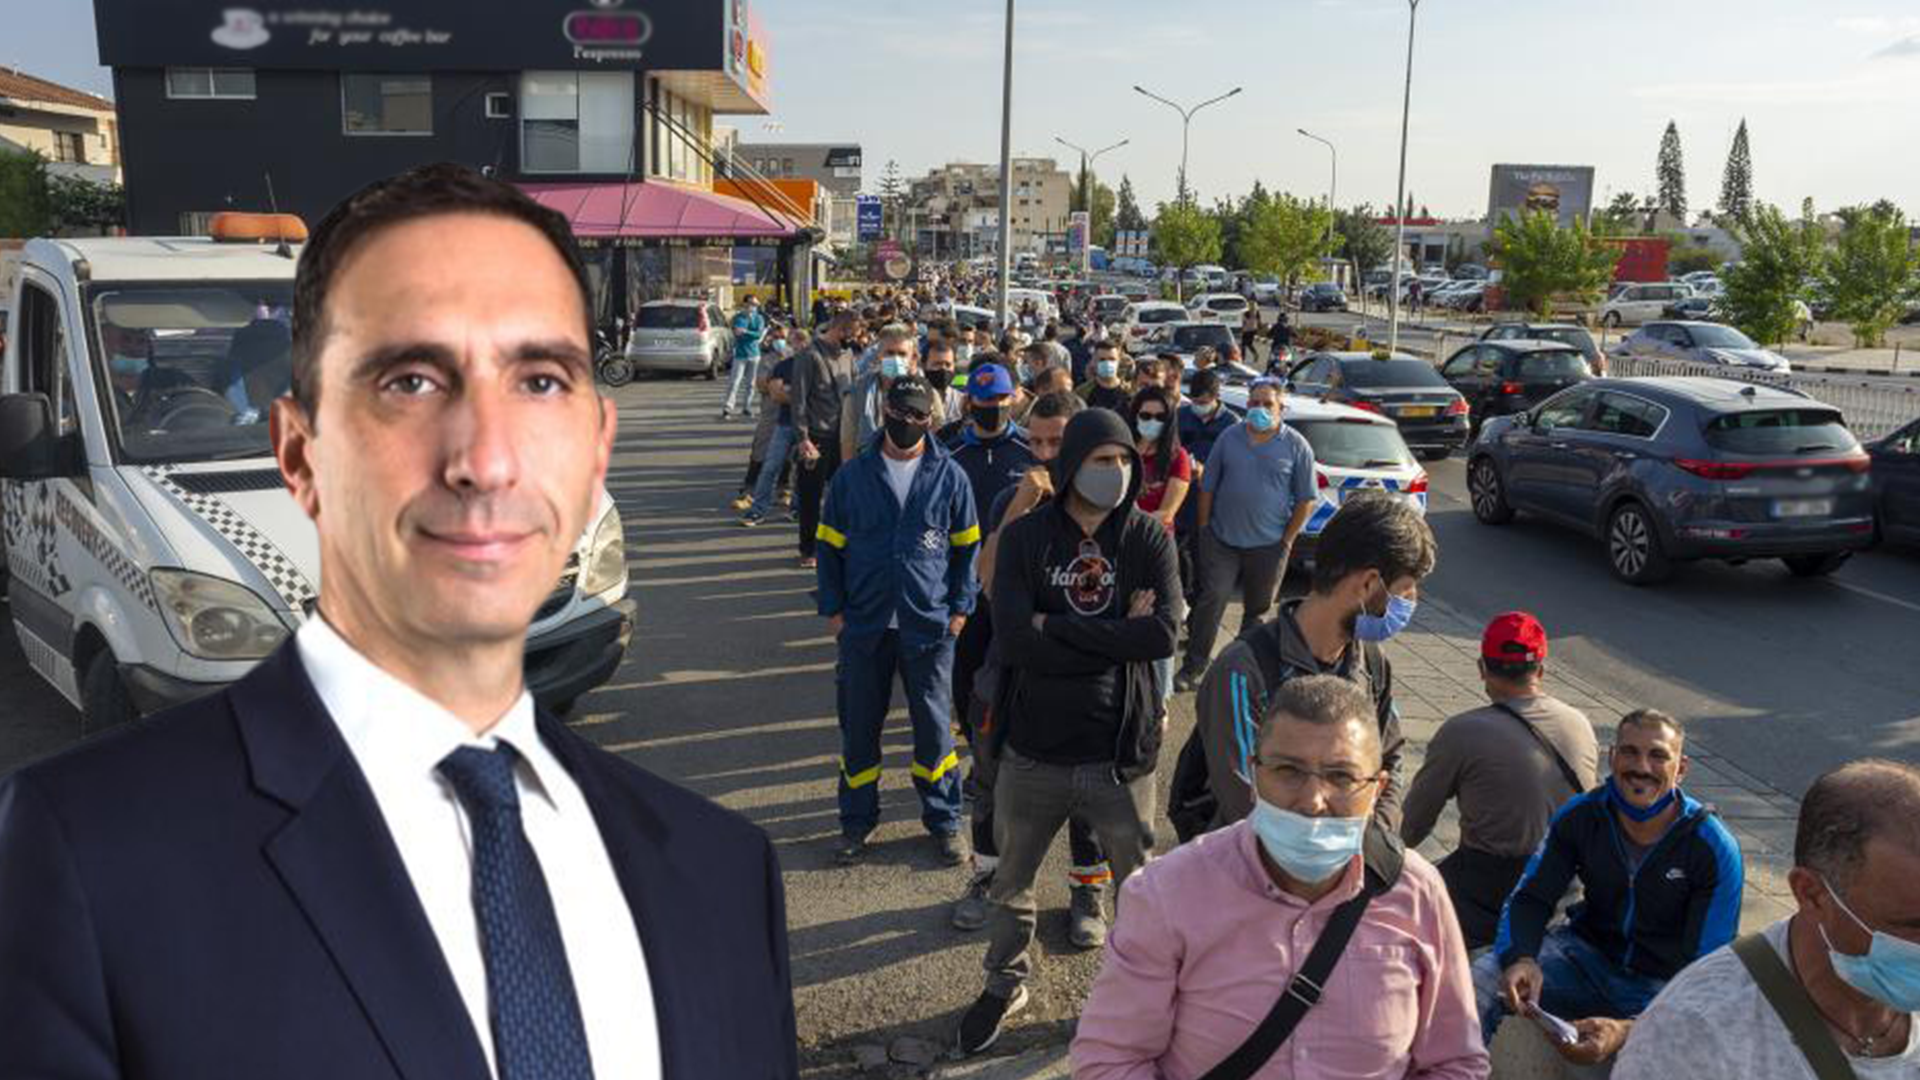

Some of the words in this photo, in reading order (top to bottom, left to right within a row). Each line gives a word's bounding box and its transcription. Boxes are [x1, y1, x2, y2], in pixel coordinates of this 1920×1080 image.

[283, 11, 342, 26] winning
[345, 10, 392, 24] choice
[308, 29, 332, 46] for
[338, 31, 373, 46] your
[379, 29, 422, 46] coffee
[425, 30, 452, 43] bar
